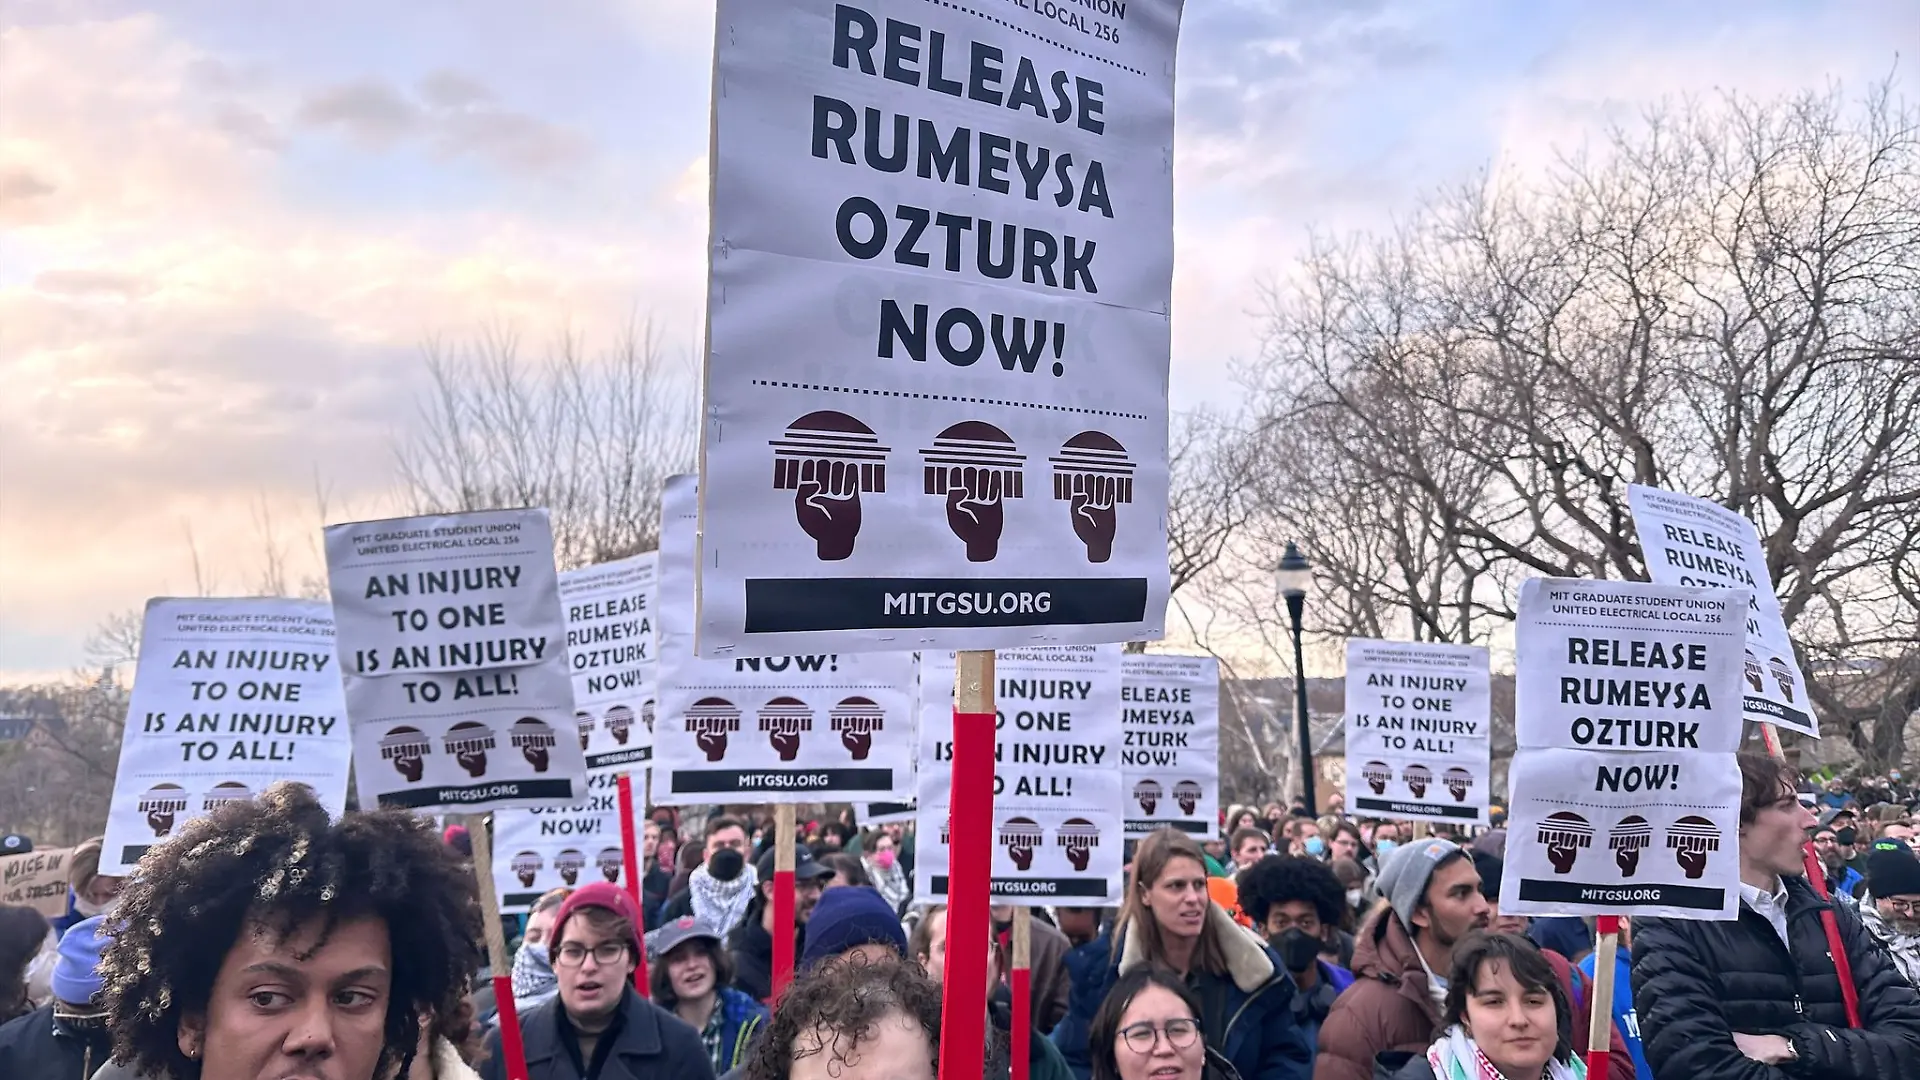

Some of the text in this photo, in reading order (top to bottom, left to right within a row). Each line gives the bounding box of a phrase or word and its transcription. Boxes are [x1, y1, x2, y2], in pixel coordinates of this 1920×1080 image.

[1034, 0, 1120, 44] LOCAL 256
[832, 4, 1105, 135] RELEASE
[811, 95, 1114, 218] RUMEYSA
[836, 196, 1098, 294] OZTURK
[877, 299, 1065, 377] NOW!
[353, 523, 521, 543] MIT GRADUATE STUDENT UNION
[1663, 524, 1745, 562] RELEASE
[357, 535, 520, 555] UNITED ELECTRICAL LOCAL 256
[1665, 548, 1757, 588] RUMEYSA
[365, 566, 521, 599] AN INJURY
[570, 594, 646, 622] RELEASE
[884, 592, 1051, 616] MITGSU.ORG
[1550, 591, 1725, 610] MIT GRADUATE STUDENT UNION
[198, 614, 250, 622] GRADUATE
[255, 615, 302, 624] STUDENT
[306, 617, 335, 626] UNIO
[392, 603, 505, 632] TO ONE
[1552, 605, 1721, 624] UNITED ELECTRICAL LOCAL 256
[220, 625, 279, 633] ELECTRICAL
[568, 618, 651, 647] RUMEYSA
[356, 637, 546, 672] IS AN INJURY
[574, 643, 646, 669] OZTURK
[1046, 654, 1076, 662] LOCAL
[1065, 645, 1096, 653] UNION
[1568, 637, 1706, 671] RELEASE
[172, 650, 329, 671] AN INJURY
[192, 682, 301, 701] TO ONE
[403, 674, 519, 703] TO ALL!
[588, 670, 642, 694] NOW!
[1000, 679, 1091, 701] INJURY
[1367, 673, 1467, 692] AN INJURY
[1121, 687, 1191, 703] ELEASE
[1381, 695, 1452, 712] TO ONE
[1561, 677, 1711, 710] RUMEYSA
[1744, 700, 1784, 716] TGSU.ORG
[144, 713, 336, 735] IS AN INJURY
[1015, 712, 1071, 731] ONE
[1357, 714, 1477, 734] IS AN INJURY
[1124, 731, 1188, 747] ZTURK
[1571, 717, 1699, 748] OZTURK
[181, 741, 295, 761] TO ALL!
[935, 742, 953, 761] IS
[1013, 745, 1106, 766] INJURY
[1382, 735, 1454, 753] TO ALL!
[1122, 751, 1177, 766] NOW!
[738, 774, 828, 787] MITGSU.ORG
[1014, 776, 1072, 797] ALL!
[1595, 765, 1679, 793] NOW!
[439, 784, 519, 801] MITGSU.ORG
[541, 819, 601, 835] NOW!
[991, 882, 1056, 893] ITGSU.ORG
[1581, 888, 1660, 901] MITGSU.ORG
